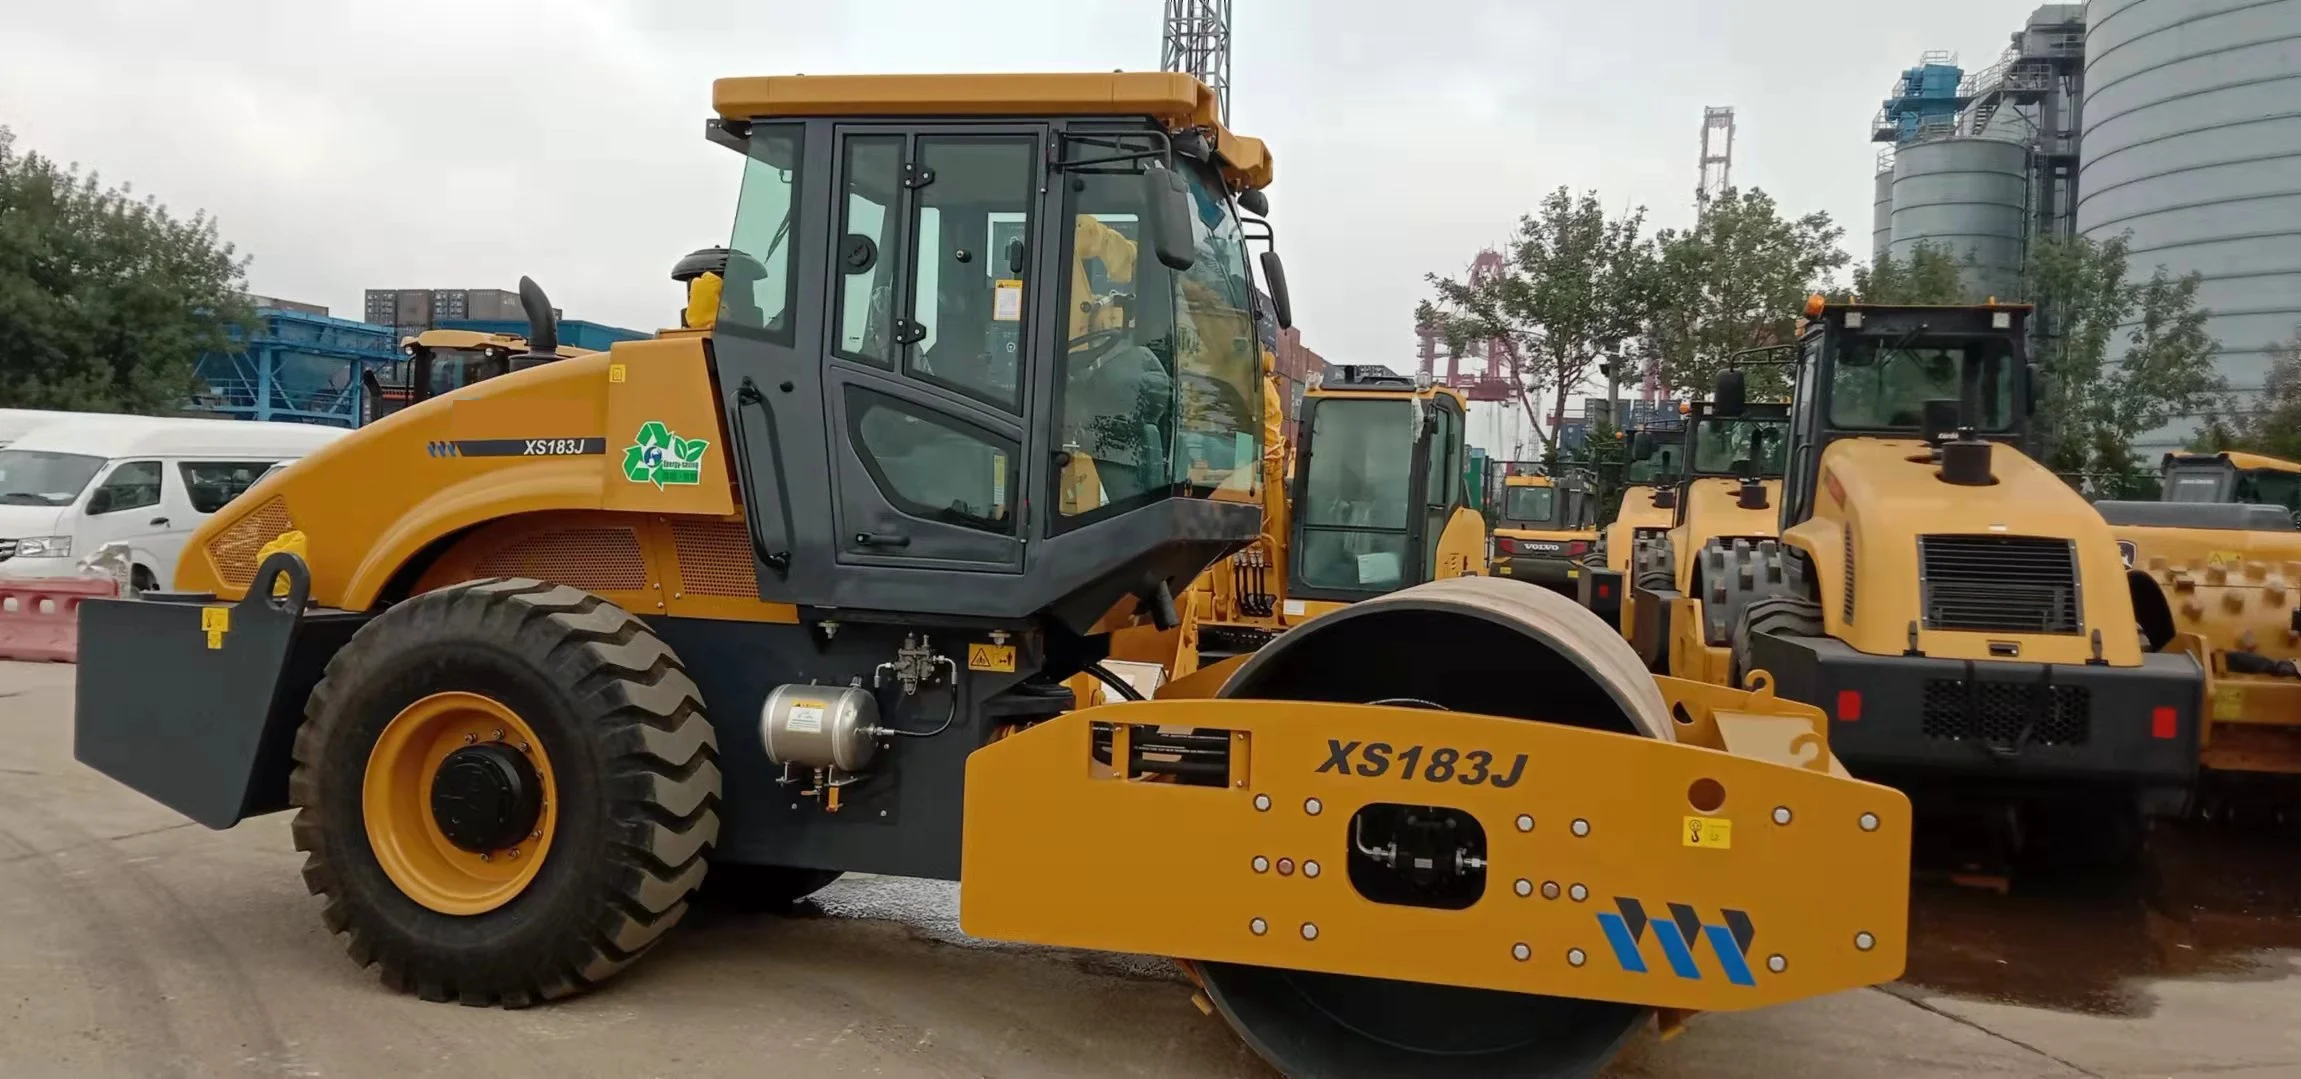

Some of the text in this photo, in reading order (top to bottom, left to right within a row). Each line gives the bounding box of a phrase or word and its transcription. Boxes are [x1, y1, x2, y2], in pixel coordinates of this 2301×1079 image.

[523, 438, 585, 455] XS183J
[1524, 543, 1560, 551] VOLVO
[1314, 739, 1529, 788] XS183J
